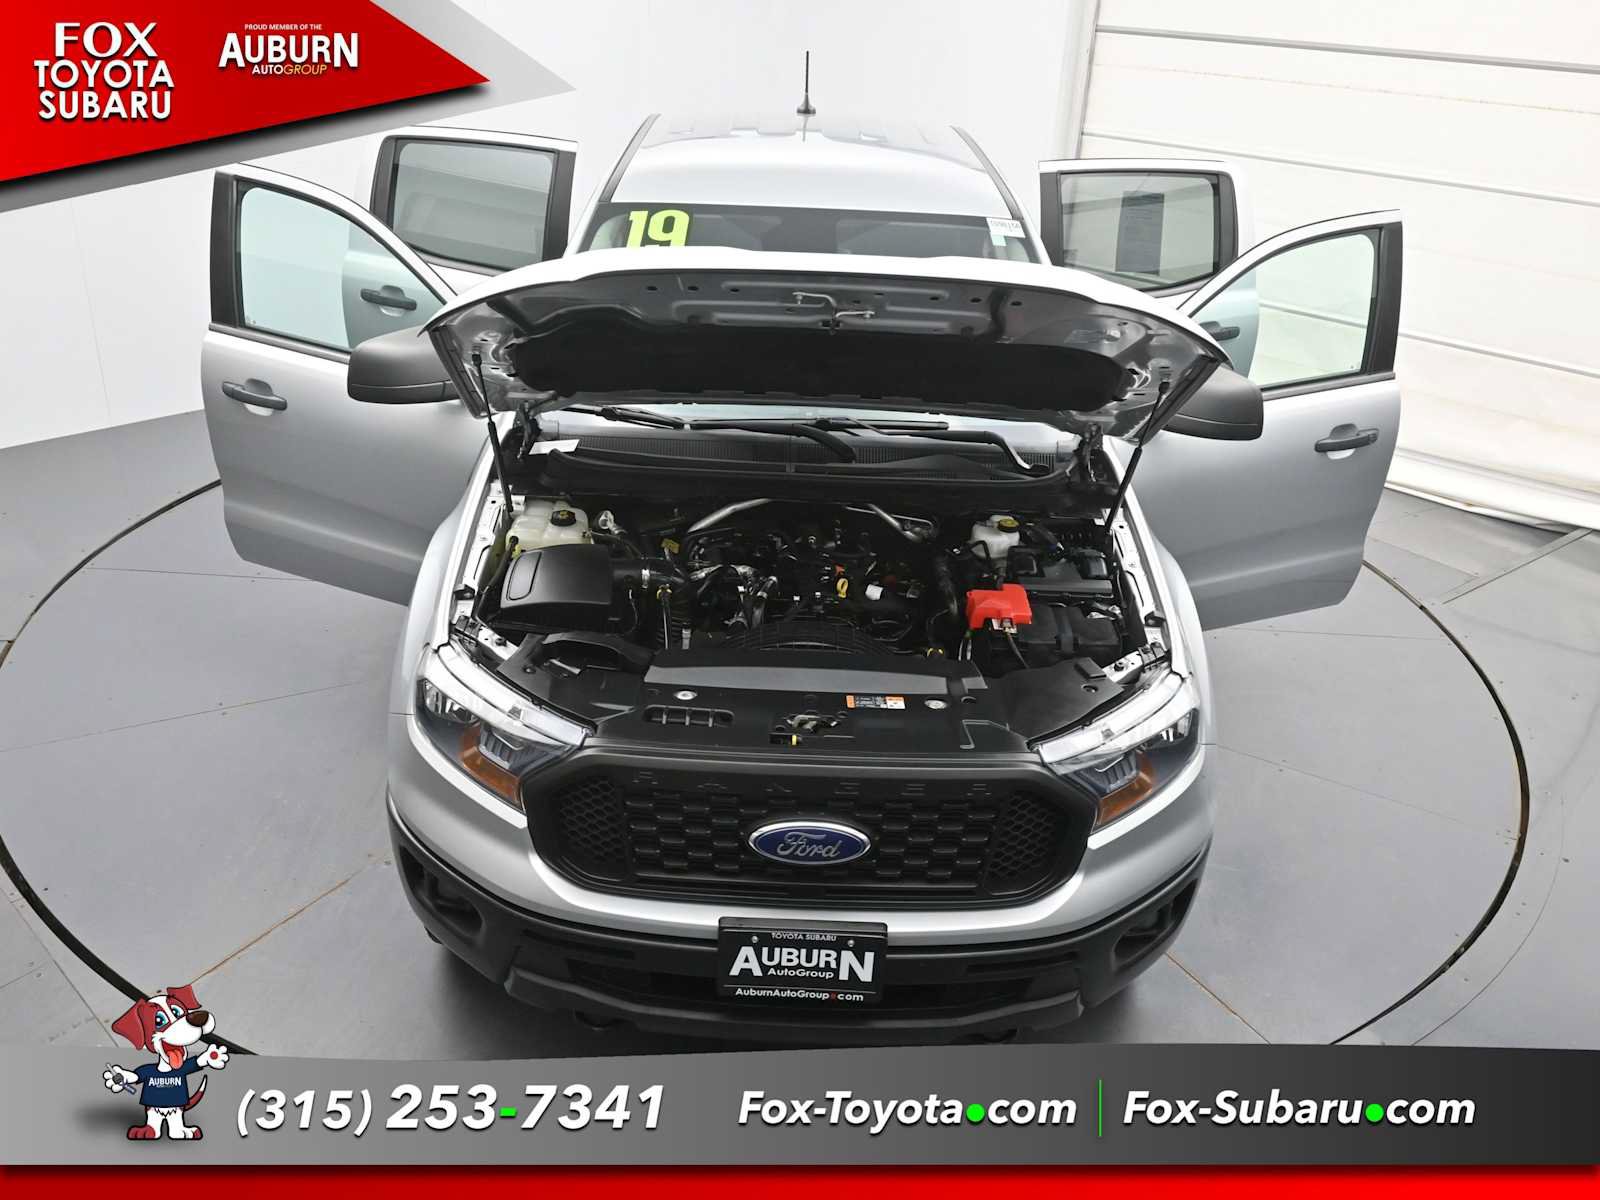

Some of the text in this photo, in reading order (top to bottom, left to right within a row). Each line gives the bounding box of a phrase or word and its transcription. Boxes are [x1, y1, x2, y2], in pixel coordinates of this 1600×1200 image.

[626, 209, 690, 248] 19
[776, 831, 843, 858] Ford
[771, 932, 837, 942] TOYOTA SUBARU
[729, 945, 875, 983] AUBURN
[767, 968, 835, 980] AutoGroup
